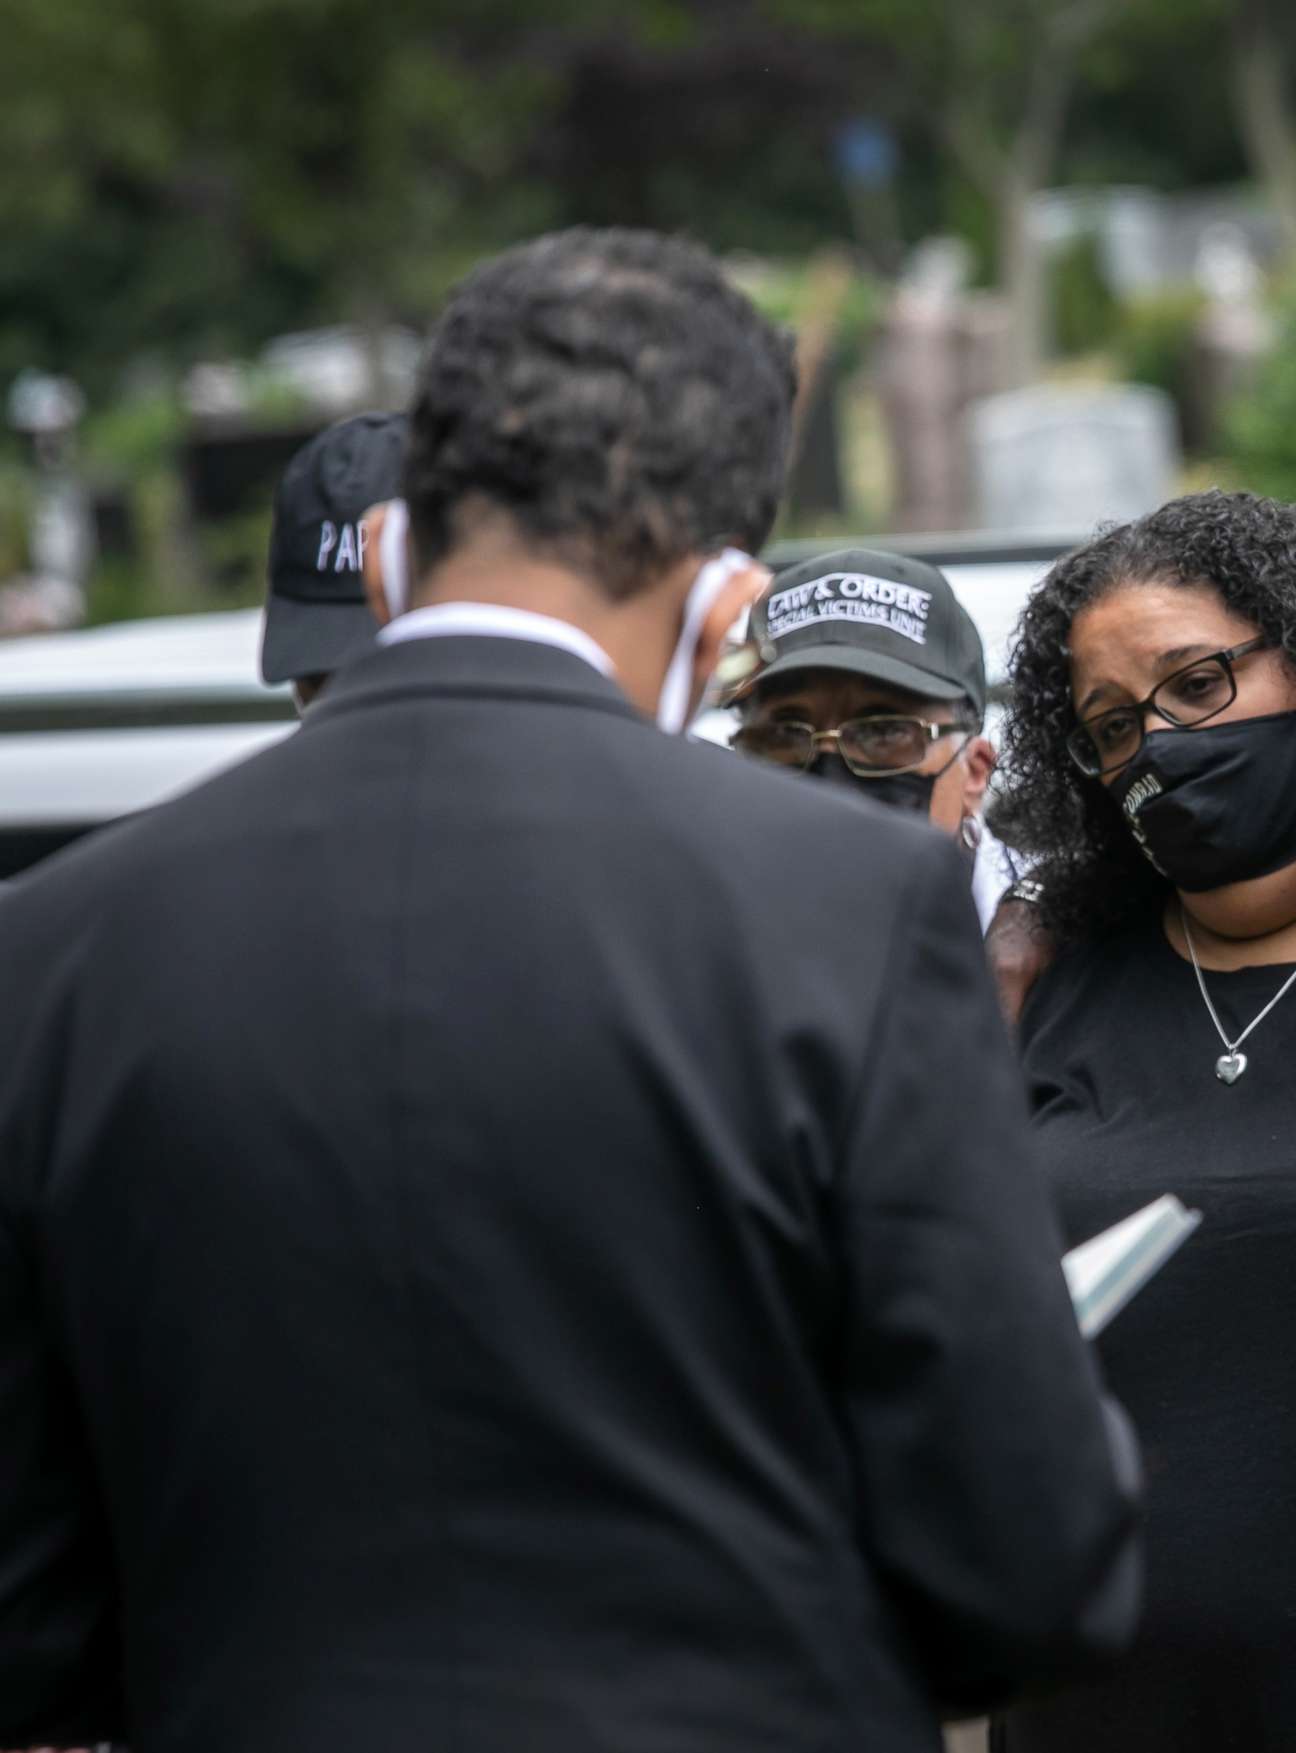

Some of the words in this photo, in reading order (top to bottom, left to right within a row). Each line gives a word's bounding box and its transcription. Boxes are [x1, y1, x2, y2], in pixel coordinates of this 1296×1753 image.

[767, 581, 817, 620] LAW
[817, 598, 889, 622] VICTIMS
[889, 608, 927, 642] UNIT
